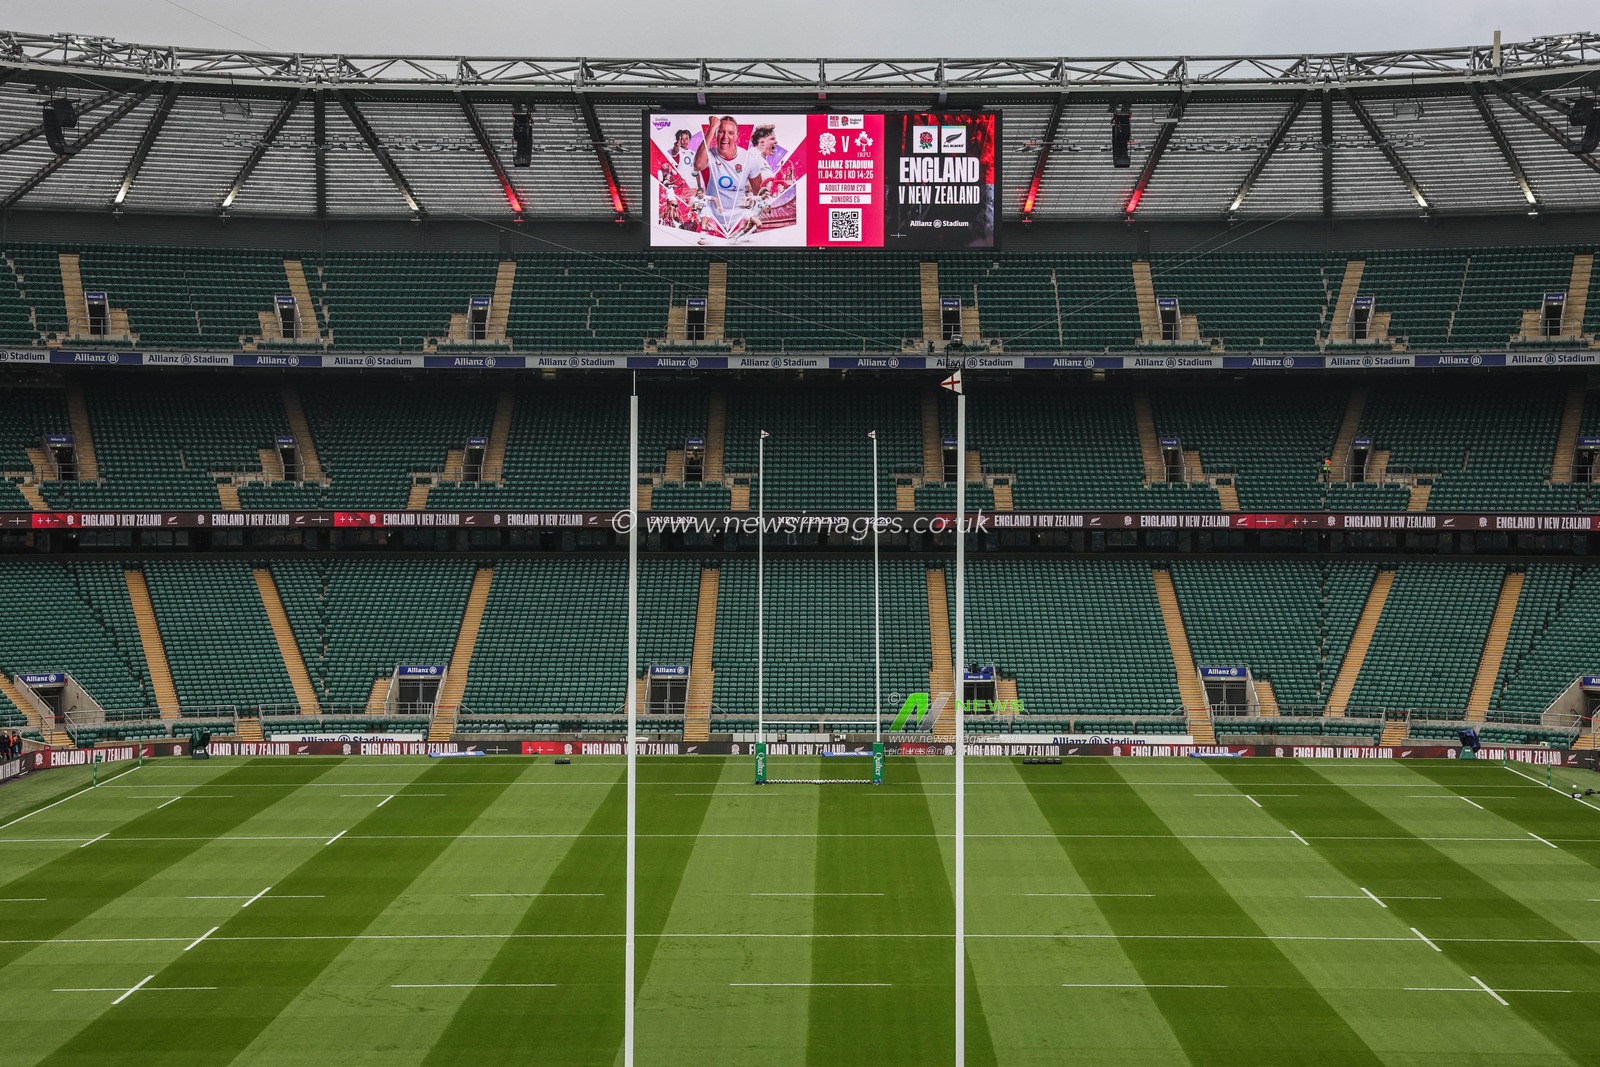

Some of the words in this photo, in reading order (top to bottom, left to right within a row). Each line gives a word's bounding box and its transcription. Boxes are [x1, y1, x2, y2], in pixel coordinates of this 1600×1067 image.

[841, 136, 850, 153] V
[818, 160, 843, 169] ALLIANZ
[845, 160, 873, 169] STADIUM
[900, 157, 980, 182] ENGLAND
[818, 170, 842, 179] 11.04.26
[848, 170, 856, 179] KO
[857, 170, 873, 179] 14:25
[898, 186, 905, 204] V
[908, 186, 931, 204] NEW
[935, 186, 980, 204] ZEALAND
[10, 352, 45, 360] Stadium
[74, 353, 106, 362] Allianz
[148, 354, 179, 362] Allianz
[193, 355, 229, 363] Stadium
[256, 356, 286, 364] Allianz
[334, 356, 363, 365] Allianz
[377, 357, 412, 365] Stadium
[454, 357, 483, 366] Allianz
[538, 357, 567, 366] Allianz
[581, 357, 615, 366] Stadium
[1330, 358, 1361, 366] Allianz
[1374, 357, 1410, 365] Stadium
[1438, 356, 1469, 364] Allianz
[1511, 354, 1542, 363] Allianz
[1557, 353, 1595, 362] Stadium
[657, 358, 686, 366] Allianz
[740, 358, 770, 366] Allianz
[783, 358, 817, 366] Stadium
[857, 358, 887, 366] Allianz
[979, 358, 1013, 367] Stadium
[1053, 358, 1082, 367] Allianz
[1134, 358, 1164, 367] Allianz
[1177, 358, 1212, 367] Stadium
[1252, 358, 1281, 366] Allianz
[81, 514, 114, 527] ENGLAND
[116, 514, 121, 526] V
[122, 514, 135, 526] NEW
[136, 514, 162, 526] ZEALAND
[212, 514, 244, 526] ENGLAND
[245, 514, 250, 526] V
[251, 514, 264, 526] NEW
[265, 514, 290, 525] ZEALAND
[383, 514, 415, 525] ENGLAND
[417, 514, 421, 525] V
[422, 514, 434, 525] NEW
[435, 514, 460, 525] ZEALAND
[507, 514, 539, 526] ENGLAND
[540, 514, 544, 526] V
[545, 514, 557, 526] NEW
[558, 514, 583, 526] ZEALAND
[994, 515, 1031, 527] ENGLAND
[1032, 516, 1037, 526] V
[1038, 516, 1053, 526] NEW
[1055, 516, 1083, 526] ZEALAND
[1141, 516, 1177, 527] ENGLAND
[1179, 516, 1184, 527] V
[1185, 516, 1200, 527] NEW
[1202, 516, 1230, 527] ZEALAND
[1345, 516, 1381, 527] ENGLAND
[1384, 516, 1388, 528] V
[1390, 516, 1405, 528] NEW
[1407, 516, 1436, 528] ZEALAND
[1496, 517, 1535, 529] ENGLAND
[1538, 517, 1542, 529] V
[1544, 517, 1560, 529] NEW
[1562, 517, 1591, 529] ZEALAND
[234, 743, 239, 755] V
[241, 744, 256, 755] NEW
[259, 744, 289, 755] ZEALAND
[360, 743, 400, 755] ENGLAND
[403, 743, 408, 754] V
[410, 743, 425, 754] NEW
[428, 743, 458, 753] ZEALAND
[582, 743, 621, 755] ENGLAND
[648, 743, 678, 755] ZEALAND
[791, 744, 795, 755] V
[798, 744, 813, 755] NEW
[1029, 745, 1060, 756] ZEALAND
[1131, 746, 1171, 756] ENGLAND
[1173, 746, 1178, 756] V
[1180, 746, 1195, 756] NEW
[1293, 747, 1333, 758] ENGLAND
[1336, 748, 1341, 758] V
[1343, 748, 1359, 758] NEW
[1361, 748, 1393, 758] ZEALAND
[51, 750, 85, 766] ENGLAND
[87, 750, 91, 764] V
[108, 747, 133, 762] ZEALAND
[1509, 750, 1514, 761] V
[1516, 750, 1532, 763] NEW
[1534, 751, 1561, 765] ZEALAND
[756, 752, 764, 776] Quilter
[874, 752, 882, 776] Quilter
